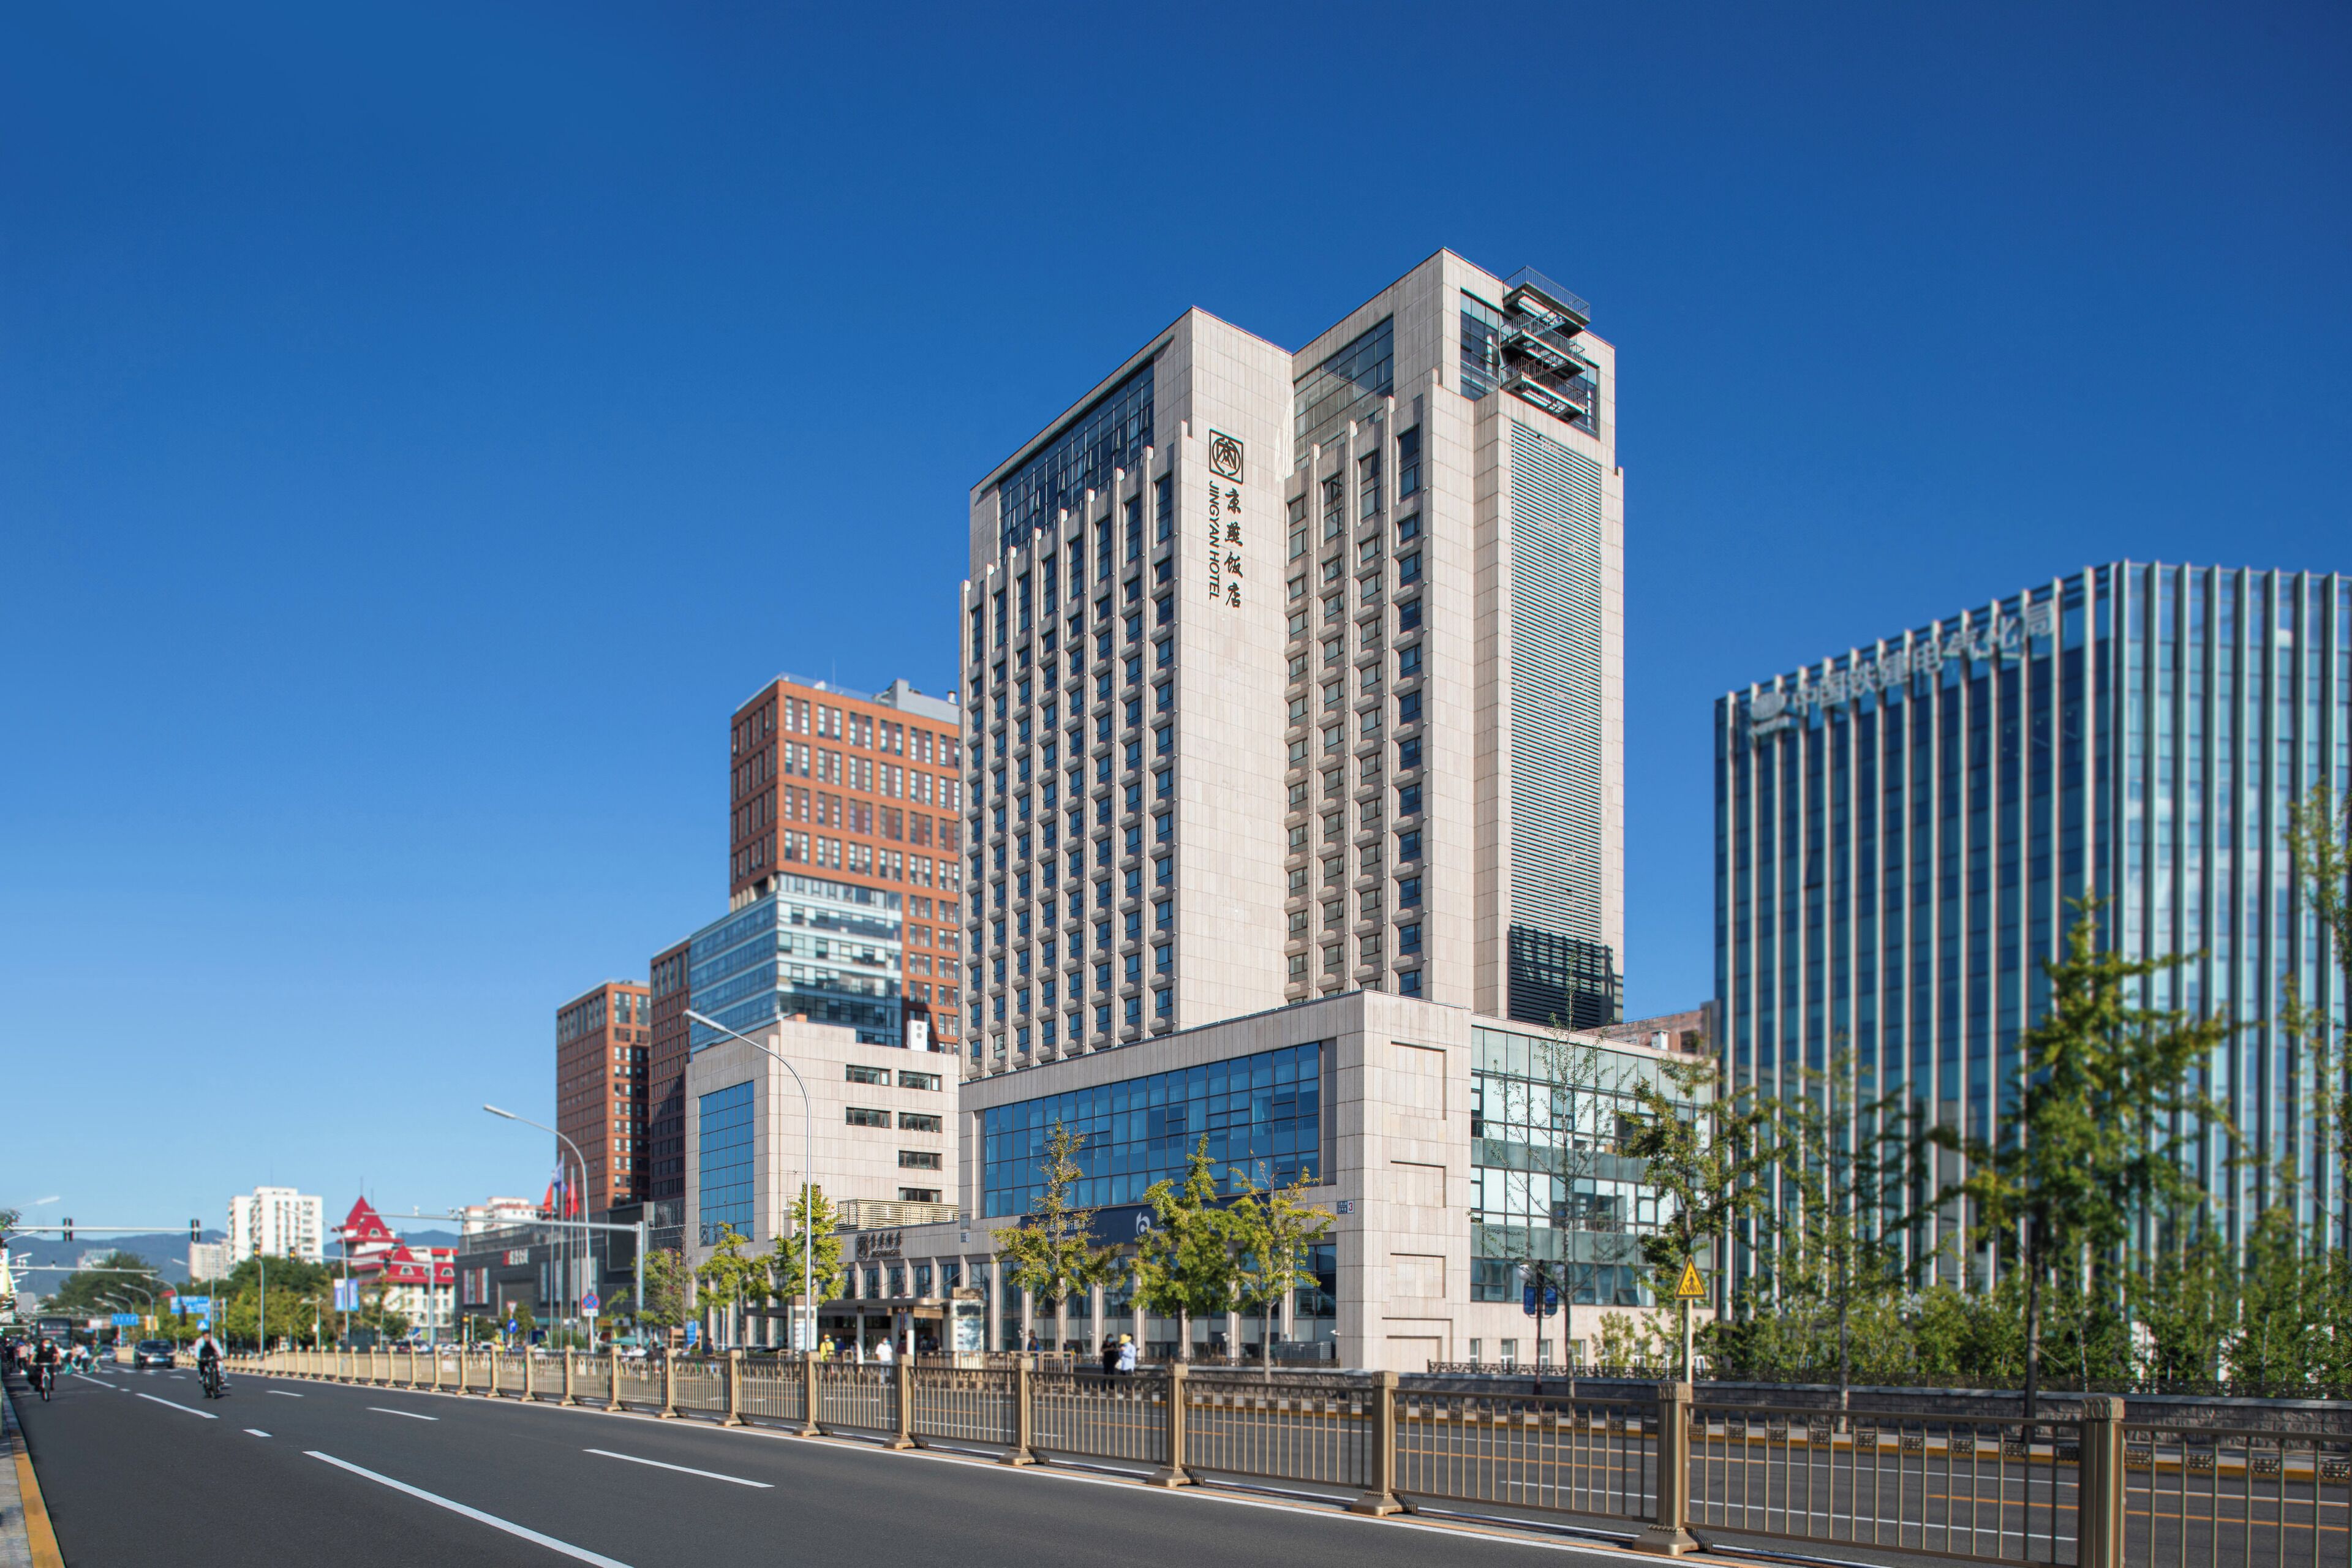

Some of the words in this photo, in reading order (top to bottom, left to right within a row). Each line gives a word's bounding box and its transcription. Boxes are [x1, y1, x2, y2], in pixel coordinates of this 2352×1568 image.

[1209, 481, 1219, 548] JINGYAN
[1224, 488, 1243, 608] 京燕饭店
[1209, 550, 1219, 600] HOTEL
